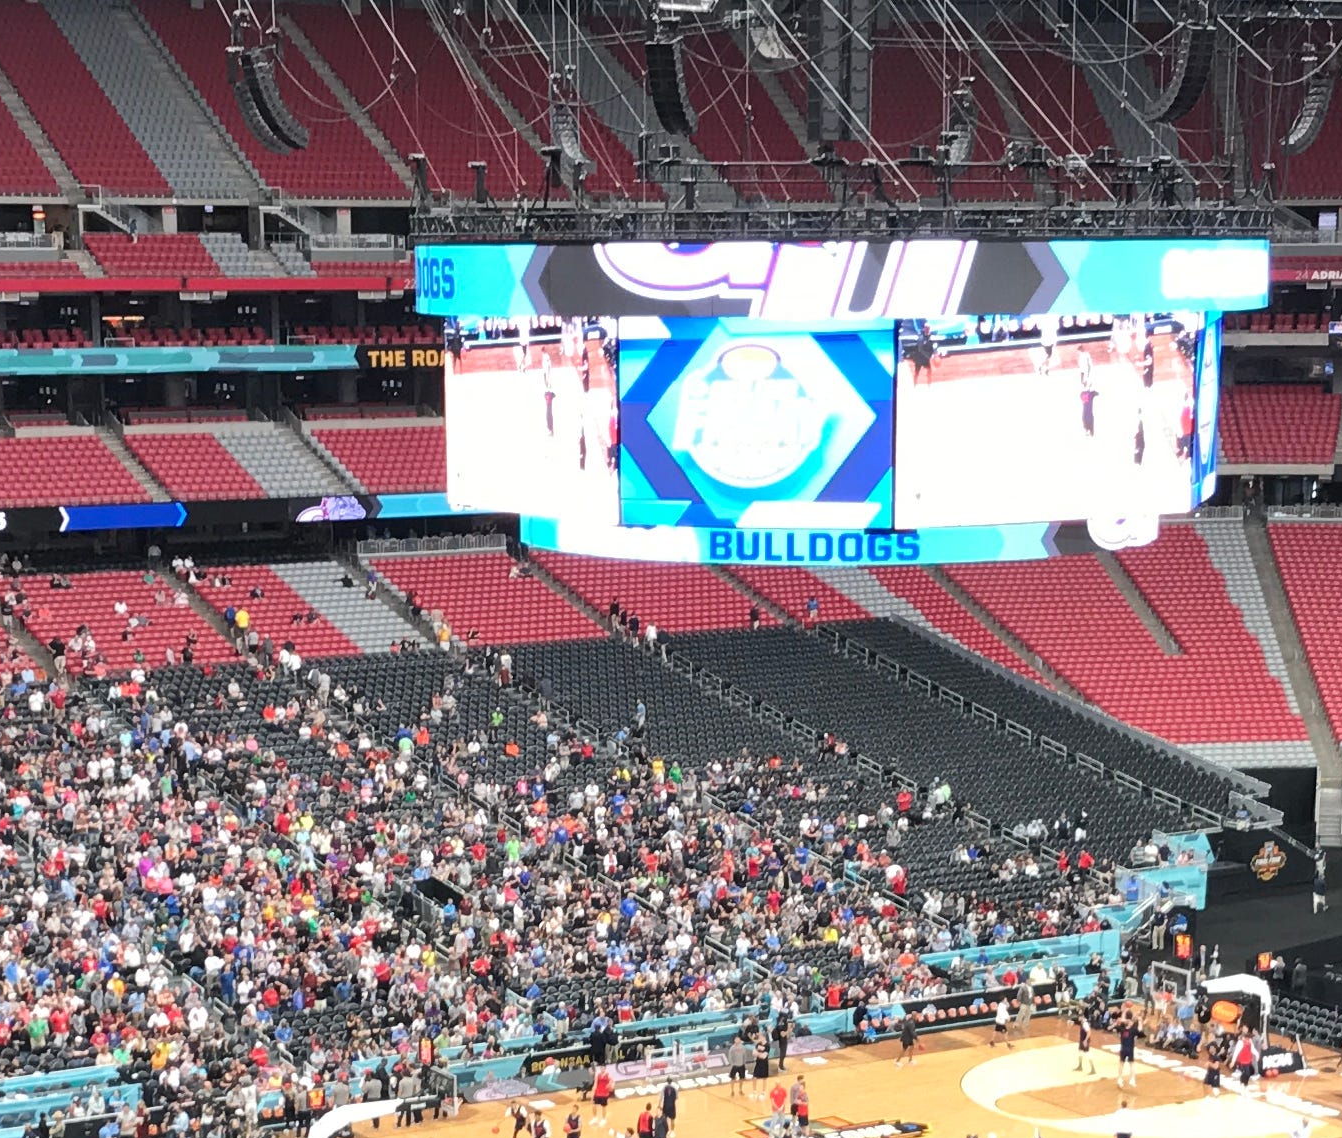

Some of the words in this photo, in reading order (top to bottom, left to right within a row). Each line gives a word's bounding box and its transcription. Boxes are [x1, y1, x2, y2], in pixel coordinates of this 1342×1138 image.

[367, 350, 406, 368] THE
[412, 350, 445, 367] RO
[708, 529, 921, 563] BULLDOGS
